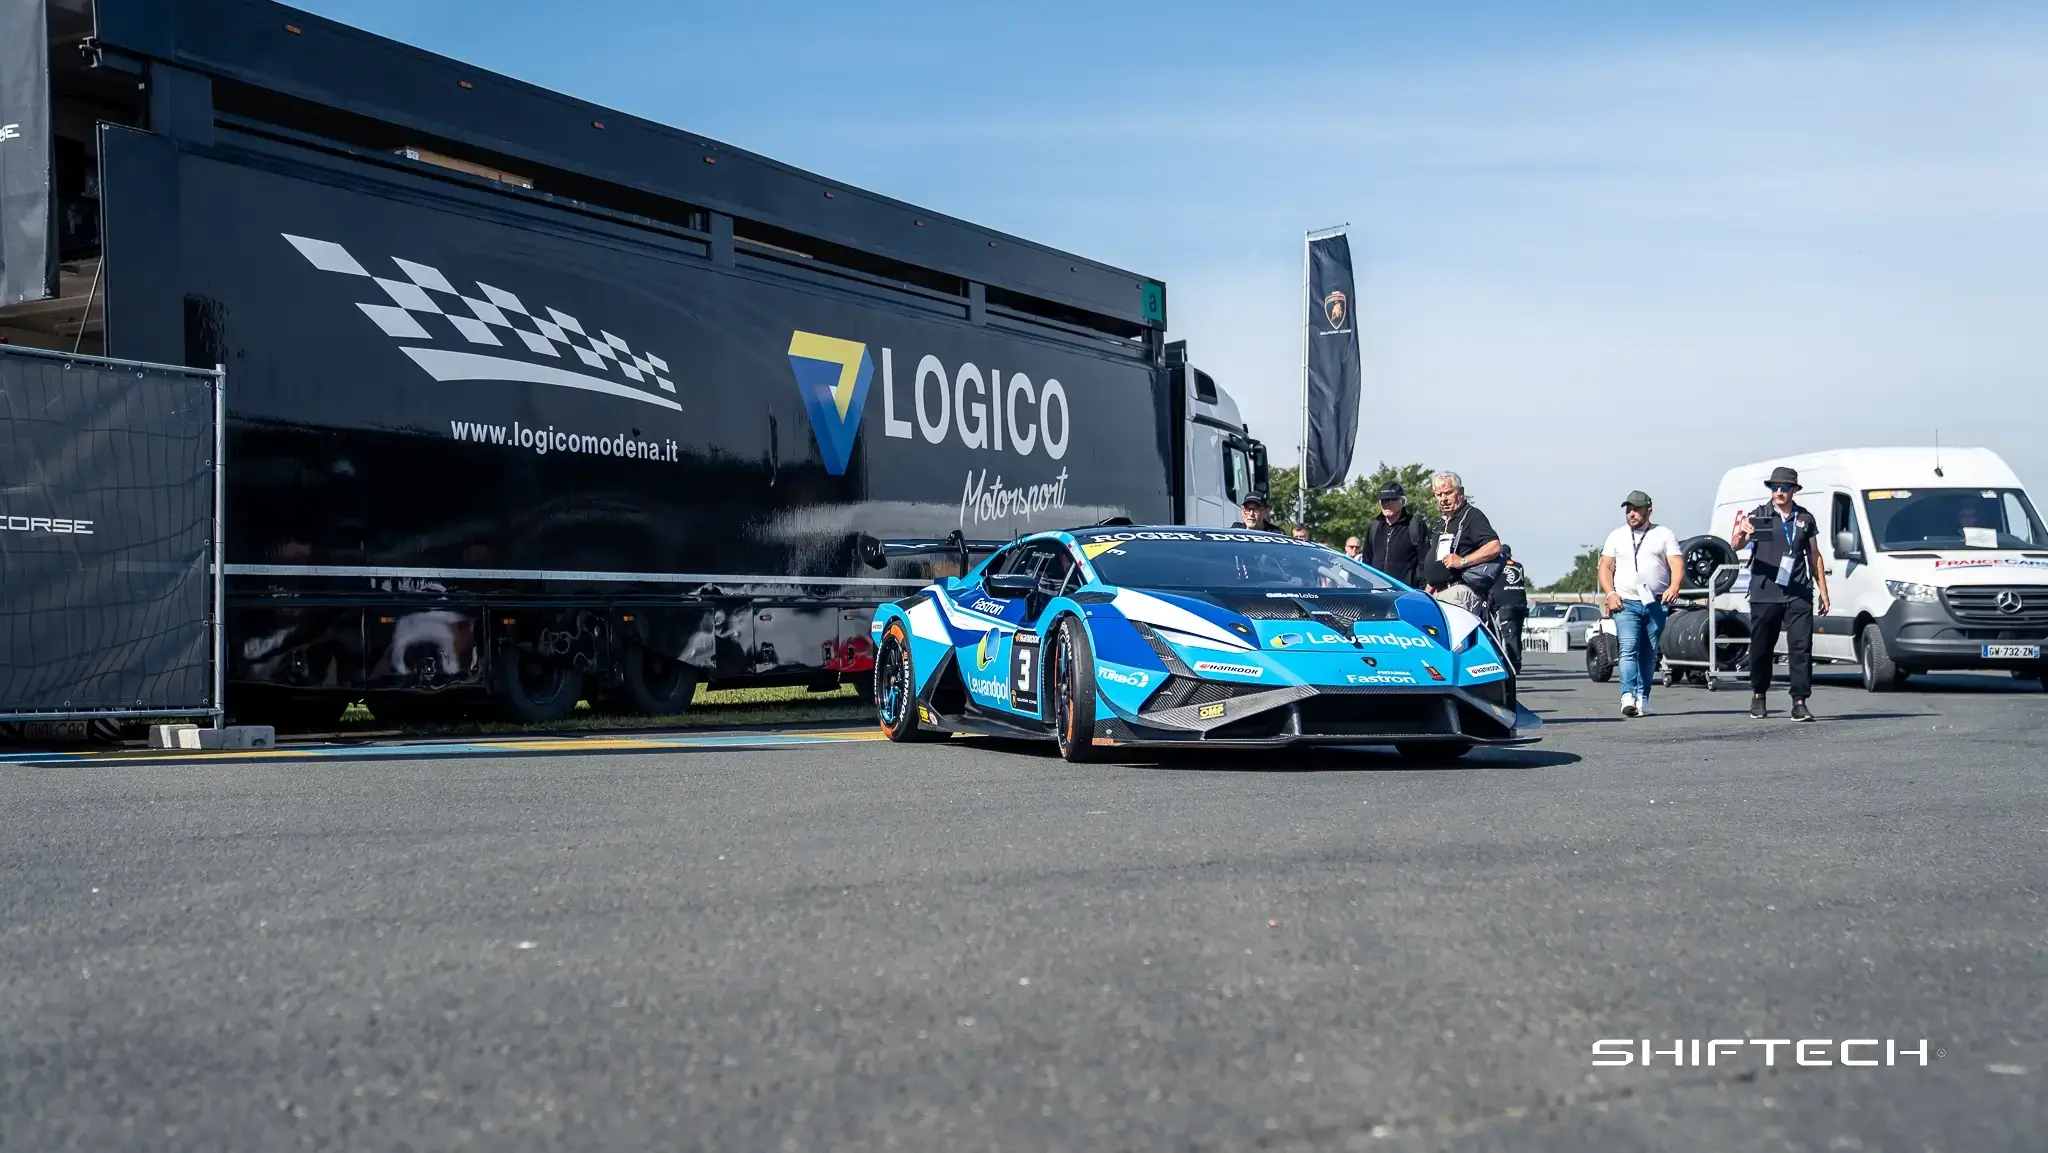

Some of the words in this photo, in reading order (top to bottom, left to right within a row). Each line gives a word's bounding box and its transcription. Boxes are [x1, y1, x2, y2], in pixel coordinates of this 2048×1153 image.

[881, 346, 1070, 460] LOGICO
[450, 420, 678, 462] www.logicomodena.it
[959, 465, 1069, 528] Motorsport
[1090, 531, 1200, 544] ROGER
[971, 597, 1005, 616] Fastron
[1306, 631, 1434, 650] Lewandpol
[1017, 648, 1031, 692] 3
[1098, 667, 1138, 685] TURBO
[1346, 674, 1417, 684] Fastron
[967, 670, 1009, 705] Lewandpol
[1199, 705, 1225, 718] OMP
